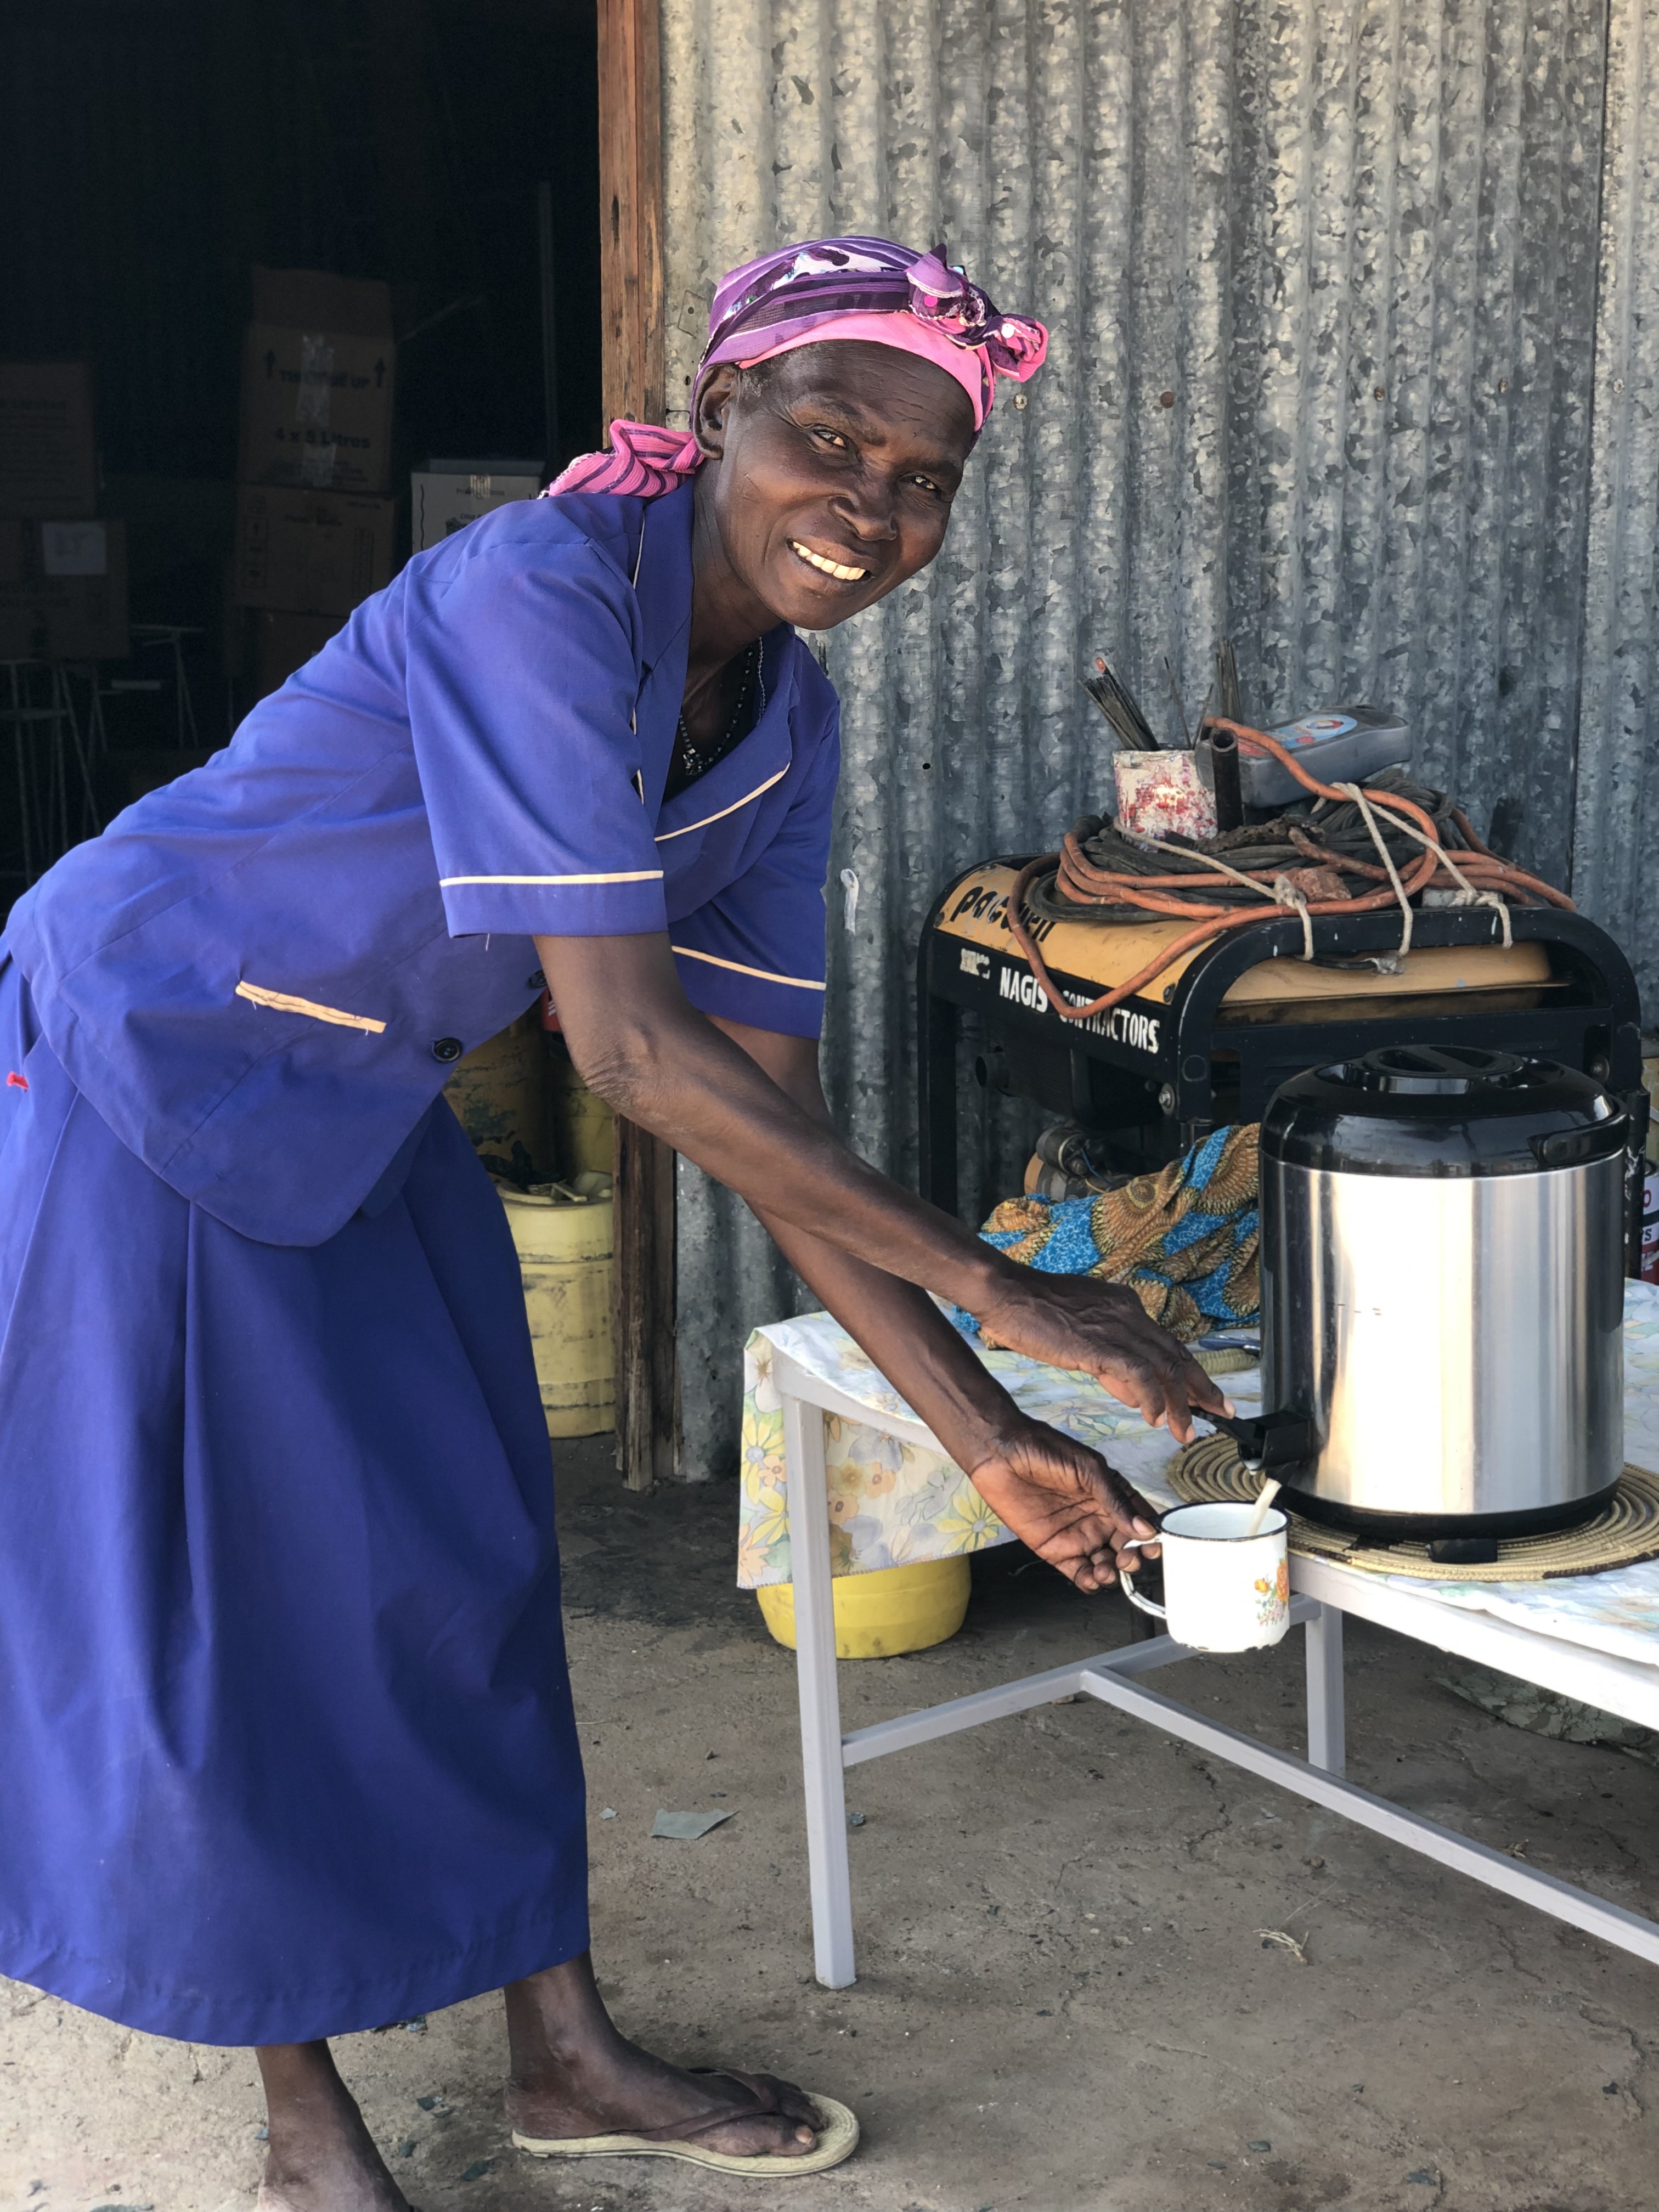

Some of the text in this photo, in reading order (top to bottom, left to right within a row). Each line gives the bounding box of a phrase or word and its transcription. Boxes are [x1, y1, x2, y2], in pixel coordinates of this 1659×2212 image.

[350, 376, 371, 389] UP
[274, 427, 285, 441] 4
[320, 430, 371, 449] Litres
[999, 966, 1160, 1054] NAGIS CONTRACTORS
